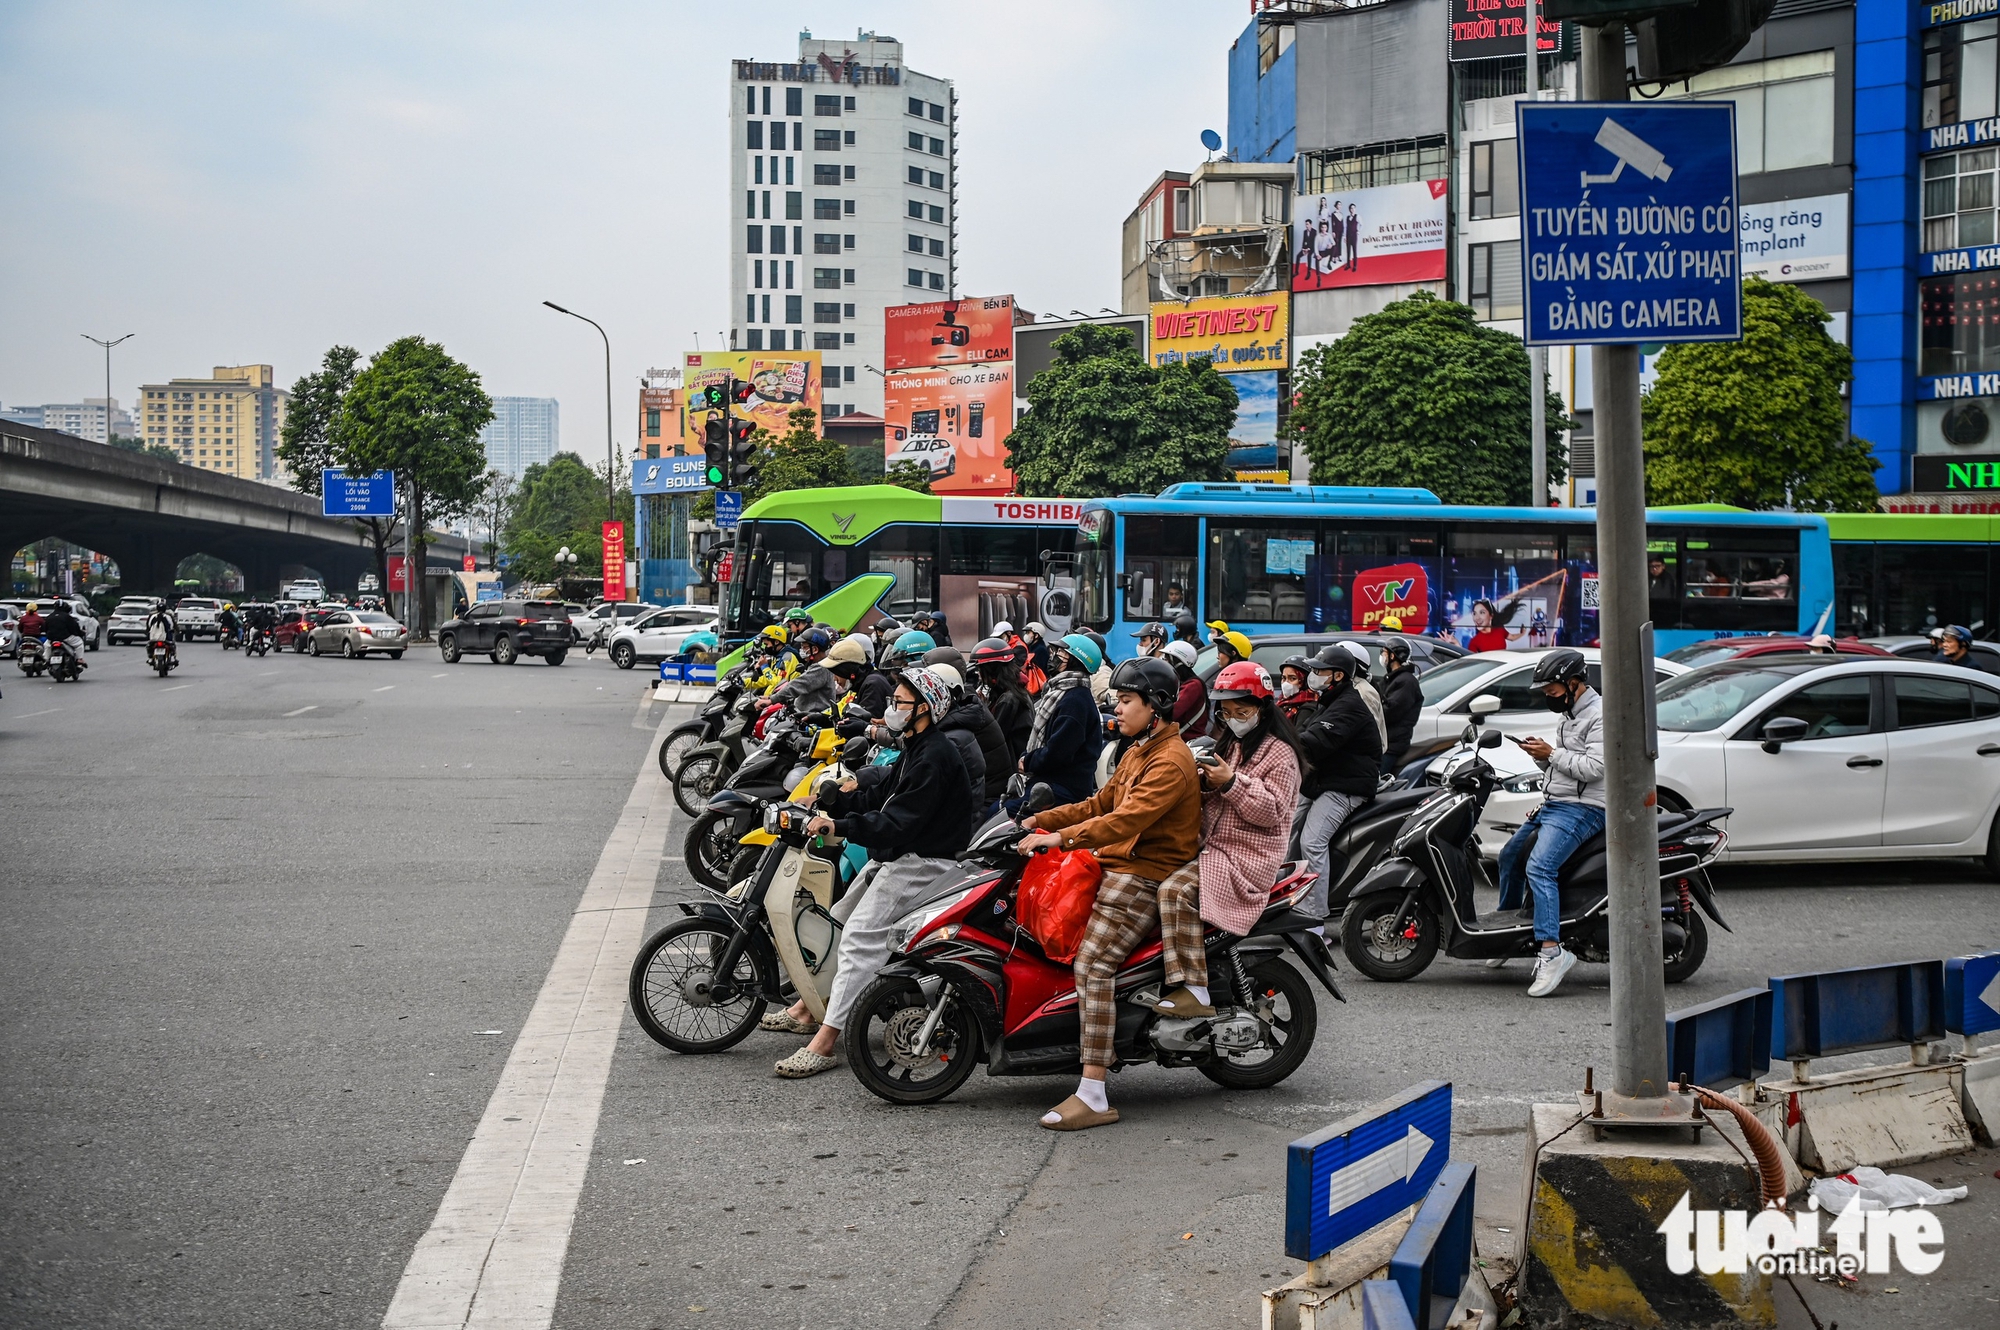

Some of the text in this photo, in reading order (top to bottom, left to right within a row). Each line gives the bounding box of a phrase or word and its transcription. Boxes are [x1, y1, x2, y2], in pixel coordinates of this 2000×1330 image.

[1452, 14, 1560, 40] THỜI TRNG
[1931, 124, 1969, 148] NHA
[1532, 190, 1731, 236] TUYẾN ĐƯỜNG CÓ
[1781, 211, 1822, 228] răng
[1423, 229, 1443, 237] FORM
[1741, 233, 1806, 256] implant
[1531, 243, 1590, 281] GIÁM
[1681, 250, 1735, 285] PHẠT
[1933, 251, 1970, 273] NHA
[888, 307, 922, 319] CAMERA
[958, 301, 982, 313] TRÌNH
[1549, 286, 1721, 331] BẰNG CAMERA
[966, 347, 1009, 361] ELLICAM
[1232, 340, 1265, 364] QUỐC
[1267, 338, 1284, 360] TẾ
[890, 372, 1009, 389] THÔNG MINH CHO XE BẠN
[1935, 376, 1973, 398] NHA
[672, 461, 706, 474] SUNS
[1946, 462, 2000, 488] NH
[345, 487, 370, 495] LỐI VÀO
[666, 475, 707, 489] BOULE
[1363, 603, 1418, 628] prime
